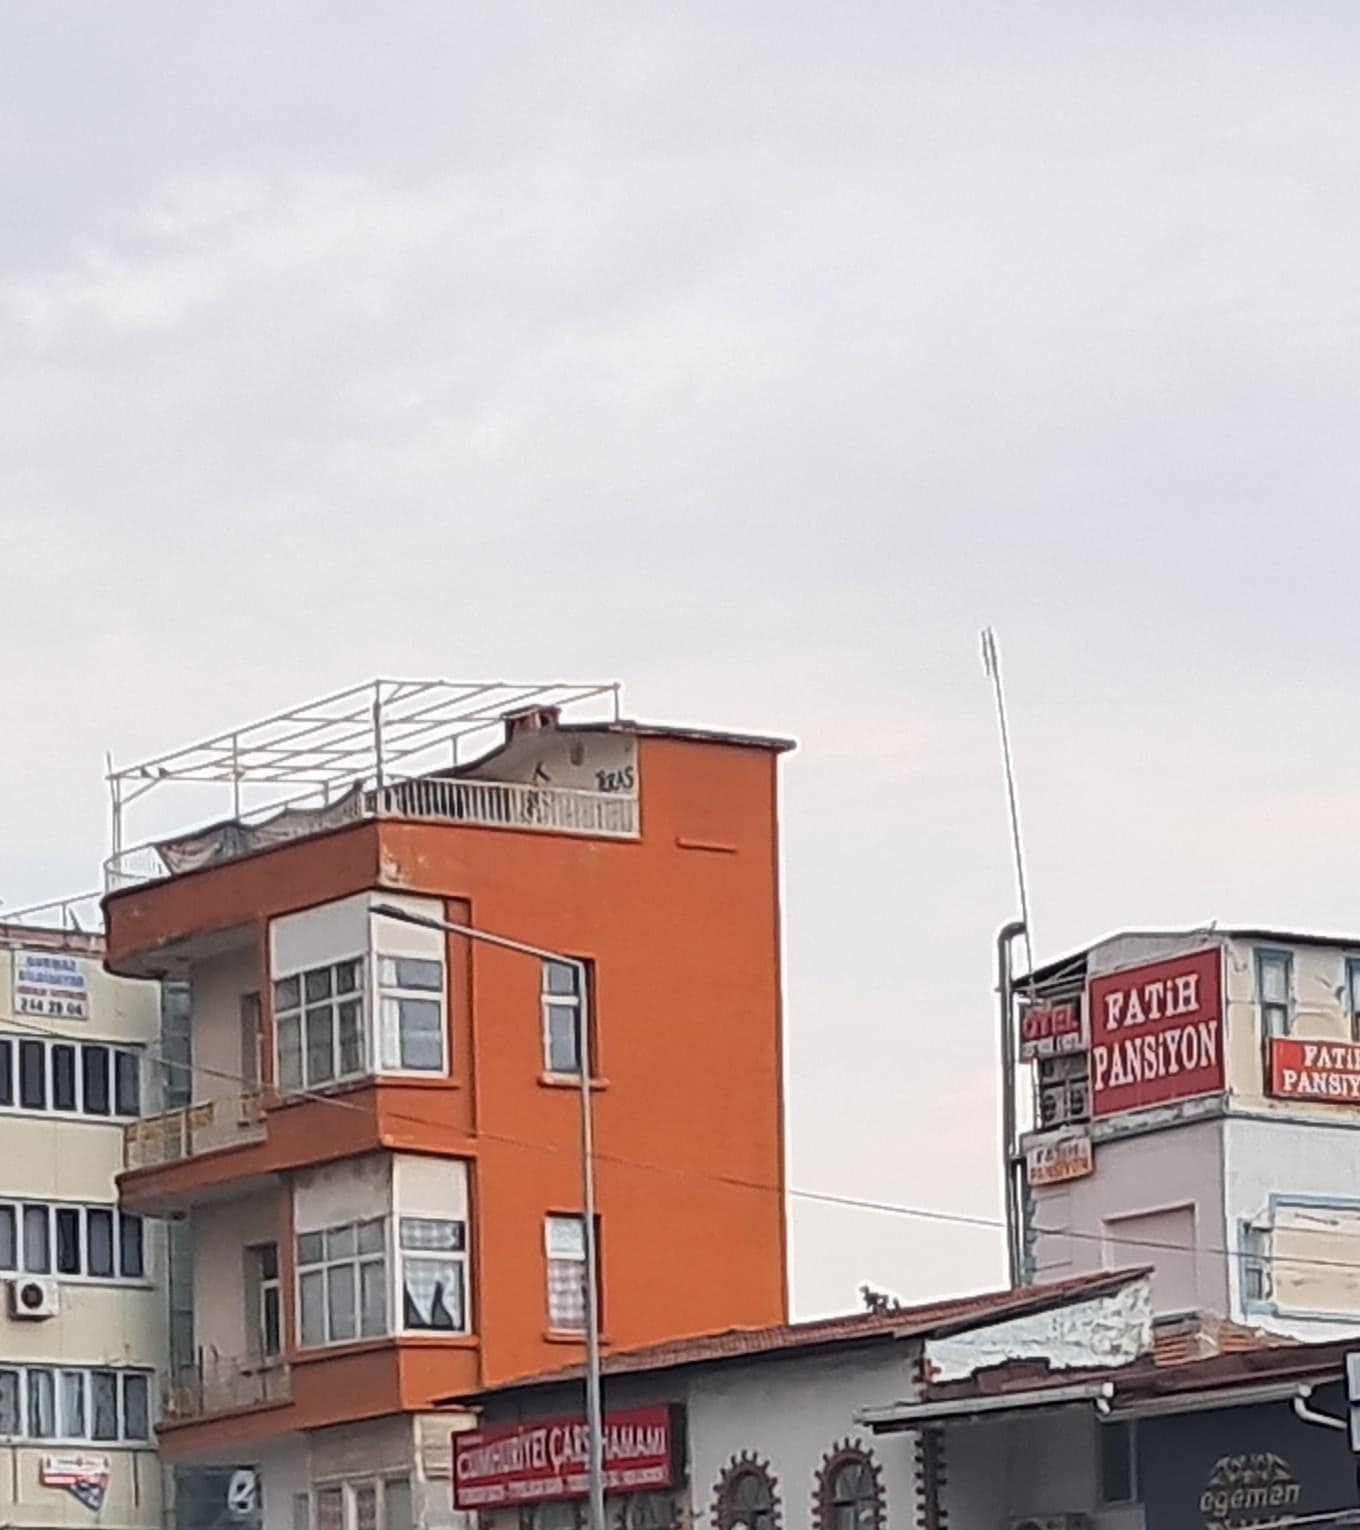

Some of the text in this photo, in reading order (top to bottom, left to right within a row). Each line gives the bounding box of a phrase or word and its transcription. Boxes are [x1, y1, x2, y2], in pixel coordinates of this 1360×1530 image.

[1104, 974, 1199, 1030] FATİH
[1093, 1021, 1218, 1091] PANSİYON
[549, 1424, 595, 1474] ÇARŞ
[1199, 1483, 1301, 1517] egemen
